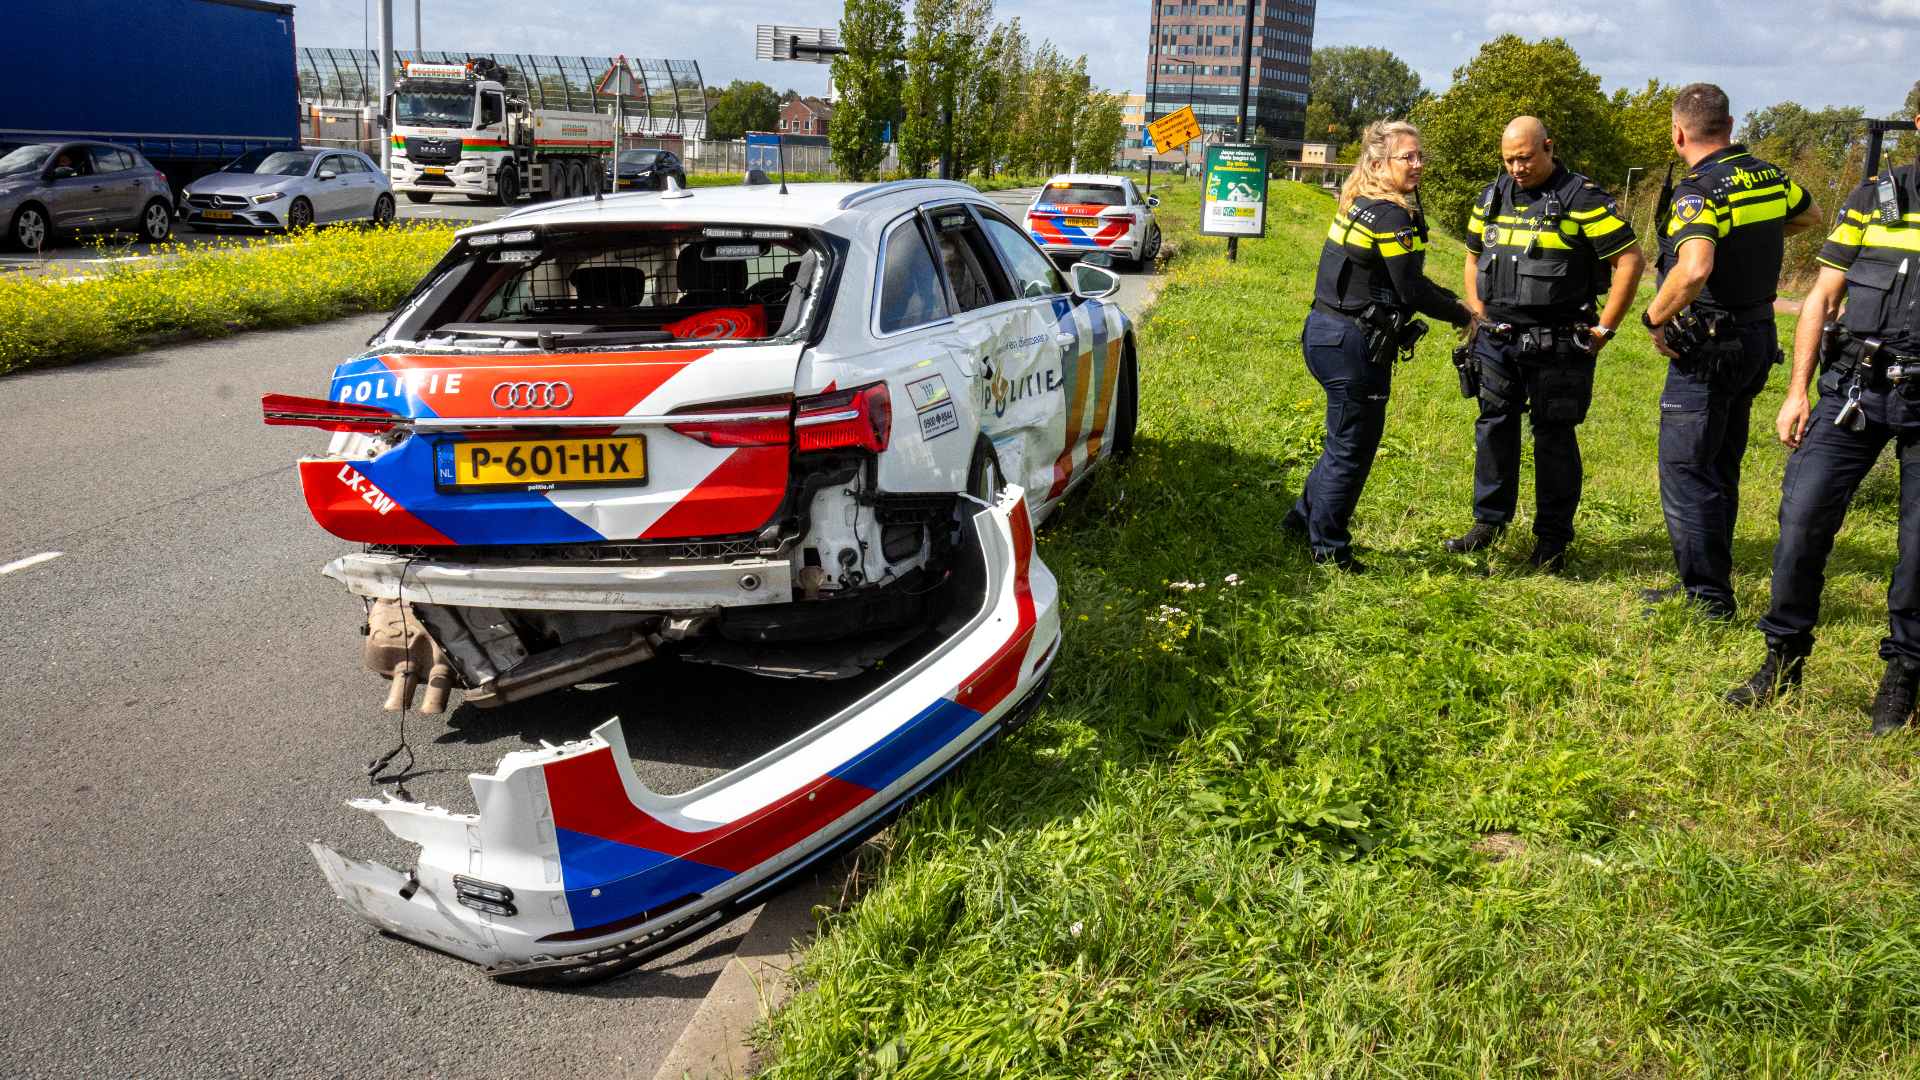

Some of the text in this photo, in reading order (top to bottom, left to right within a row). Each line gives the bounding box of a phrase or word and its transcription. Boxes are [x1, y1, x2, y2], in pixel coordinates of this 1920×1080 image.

[1156, 112, 1184, 129] Bouwverkeer
[420, 146, 446, 154] MAN
[1730, 168, 1779, 189] POLITIE
[922, 383, 935, 397] 112
[984, 369, 1054, 418] POLITIE
[471, 443, 630, 478] P-601-HX
[440, 468, 453, 478] NL
[337, 464, 396, 516] LX-ZW
[527, 483, 555, 492] politie.nl
